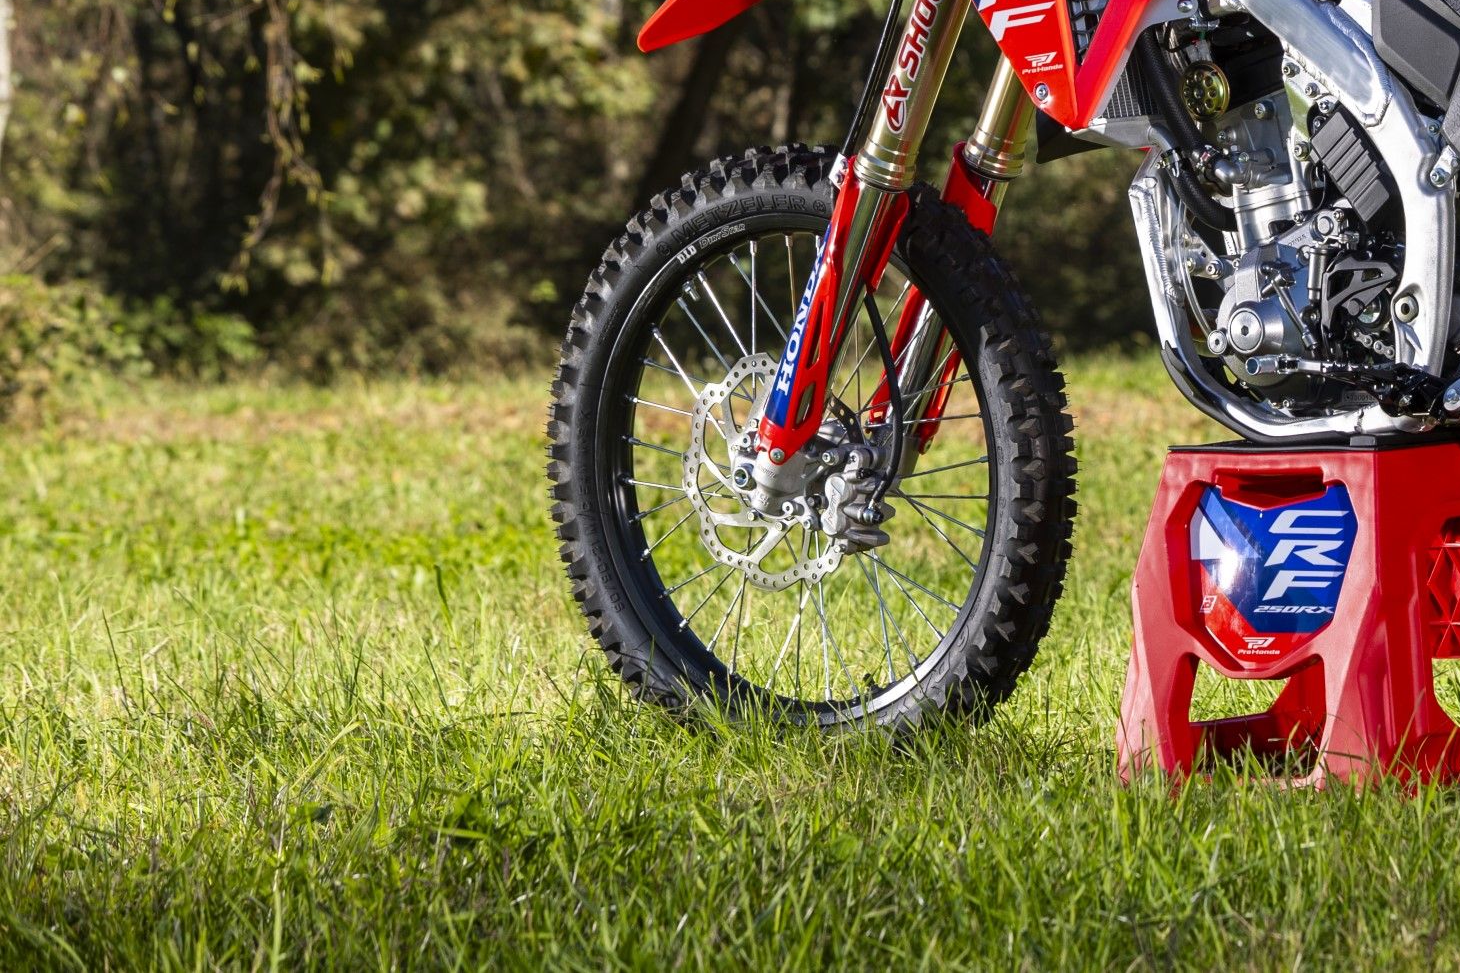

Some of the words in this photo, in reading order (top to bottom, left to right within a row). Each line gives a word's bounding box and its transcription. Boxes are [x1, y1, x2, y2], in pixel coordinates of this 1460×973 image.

[1022, 64, 1063, 75] ProHonda
[671, 194, 807, 245] METZELER
[1253, 605, 1335, 614] 250RX
